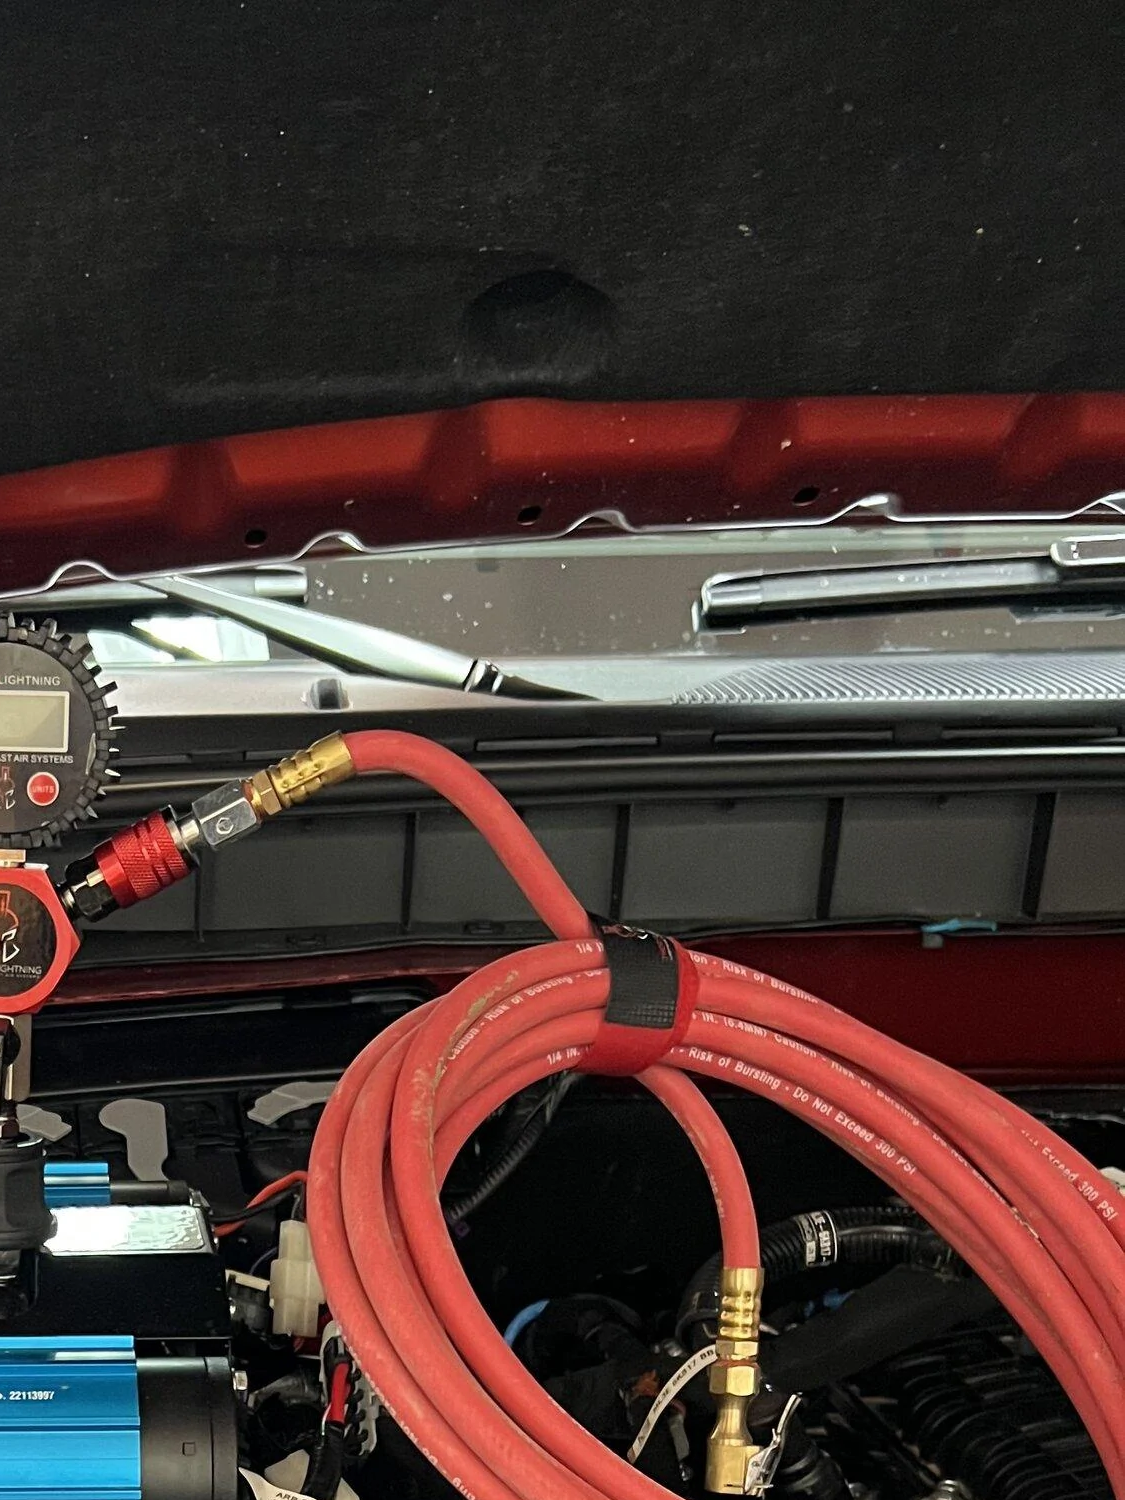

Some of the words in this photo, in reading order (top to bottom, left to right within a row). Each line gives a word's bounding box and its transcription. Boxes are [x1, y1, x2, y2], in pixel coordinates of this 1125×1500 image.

[13, 754, 29, 763] AIR
[30, 754, 74, 764] SYSTEMS
[32, 785, 55, 794] UNITS
[546, 1050, 562, 1065] 1/4
[688, 1047, 713, 1063] Risk
[718, 1056, 732, 1068] of
[734, 1060, 782, 1090] Bursting
[792, 1086, 810, 1102] Do
[811, 1098, 833, 1116] Not
[834, 1110, 876, 1143] Exceed
[874, 1139, 896, 1159] 300
[896, 1157, 918, 1175] PSI
[1077, 1180, 1099, 1202] 300
[1097, 1199, 1120, 1221] PSI
[9, 1390, 55, 1400] 22113997
